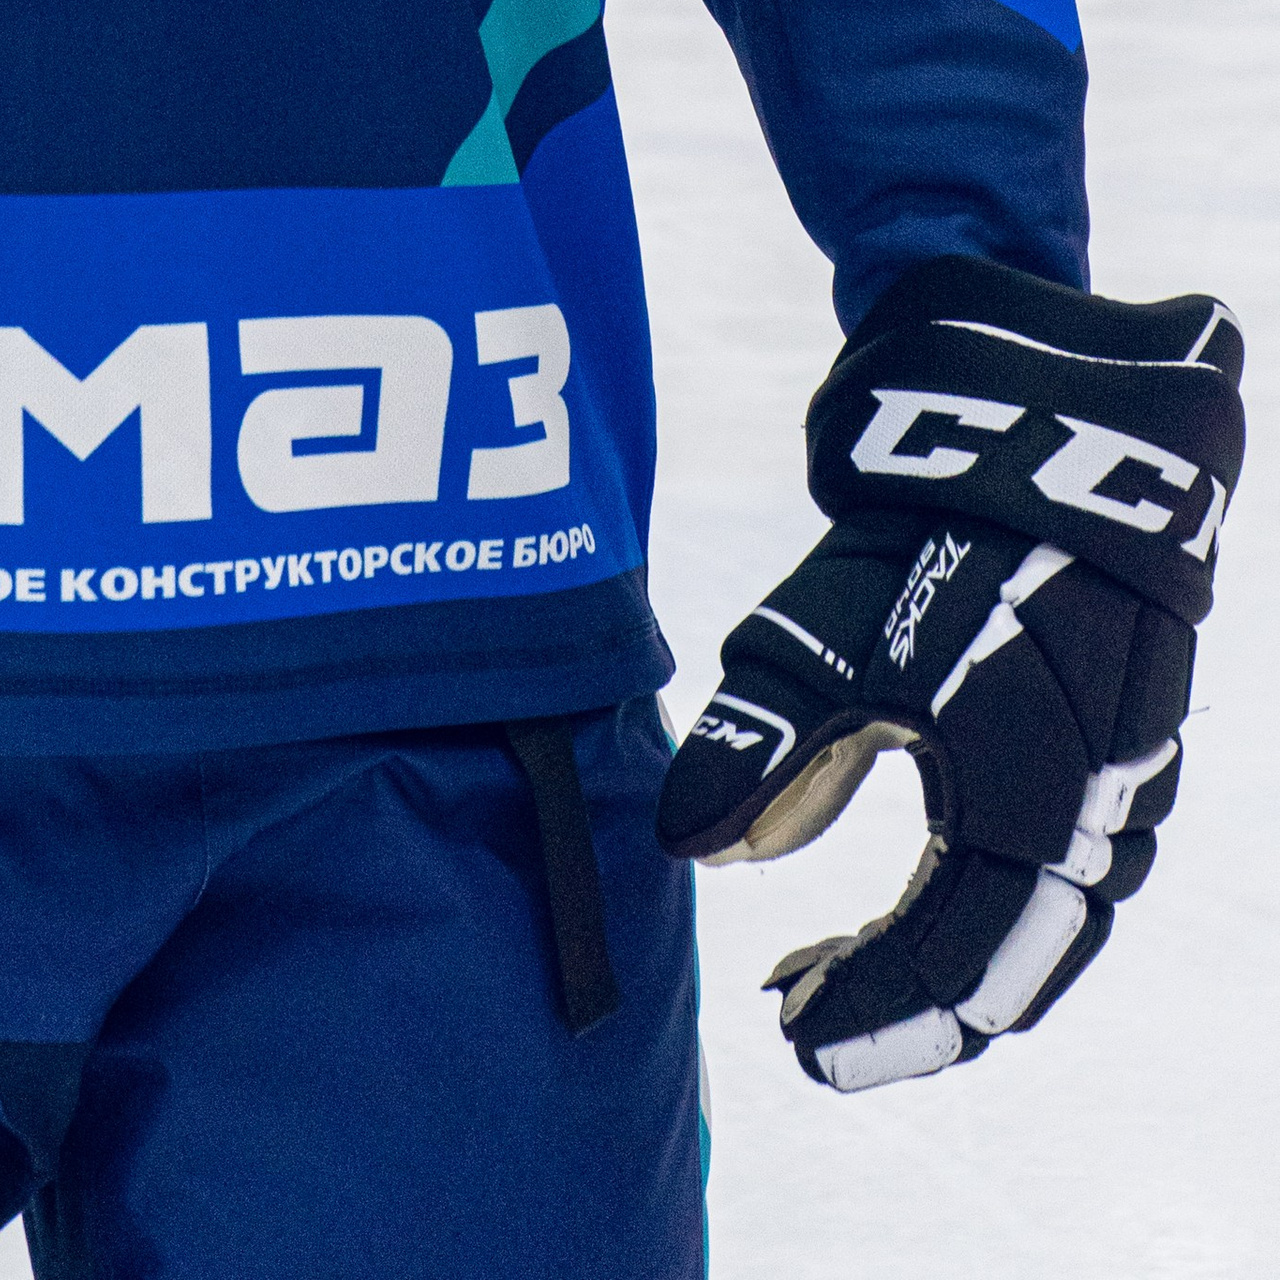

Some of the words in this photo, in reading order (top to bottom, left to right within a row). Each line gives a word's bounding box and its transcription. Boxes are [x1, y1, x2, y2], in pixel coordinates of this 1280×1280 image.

[60, 539, 504, 602] КОНСТРУКТОРСКОЕ
[513, 523, 596, 568] БЮРО
[889, 530, 971, 671] TACKS
[691, 714, 764, 752] CM
